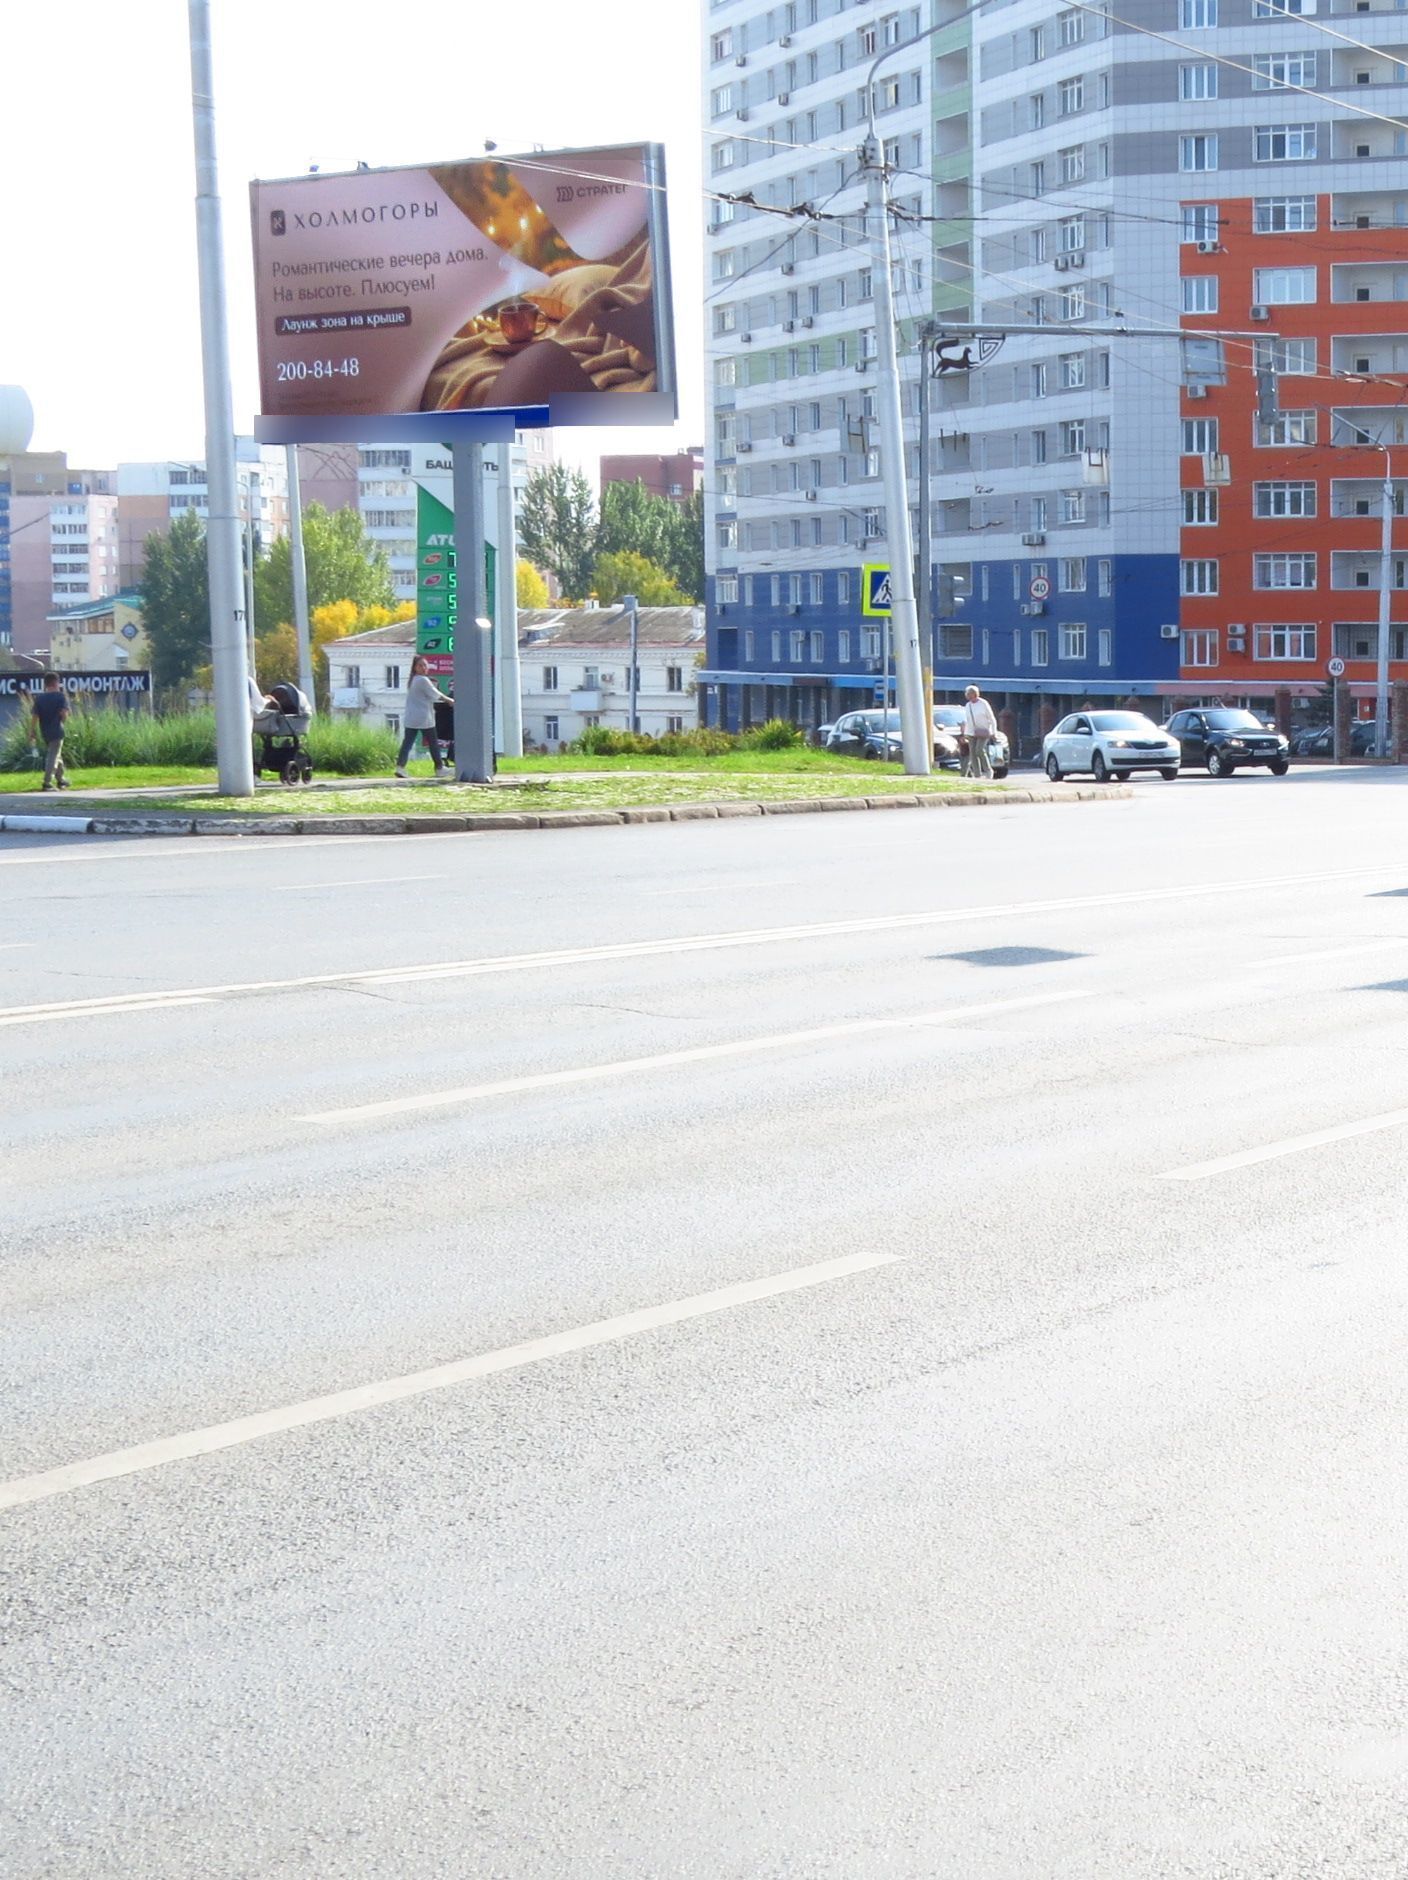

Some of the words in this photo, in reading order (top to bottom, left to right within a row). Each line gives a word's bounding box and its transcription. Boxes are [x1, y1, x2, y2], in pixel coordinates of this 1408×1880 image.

[293, 201, 438, 230] ХОЛМОГОРЫ
[272, 257, 385, 277] Романтические
[390, 251, 441, 270] вечера
[446, 247, 489, 265] дома.
[273, 285, 294, 303] На
[361, 273, 435, 297] Плюсуем!
[281, 318, 318, 333] Лаунж
[321, 316, 347, 328] зона
[350, 315, 364, 325] на
[366, 311, 406, 328] крыше
[277, 358, 360, 381] 200-84-48
[1033, 583, 1046, 593] 40
[1330, 661, 1343, 672] 40
[30, 676, 145, 694] ШНОМОНТАЖ
